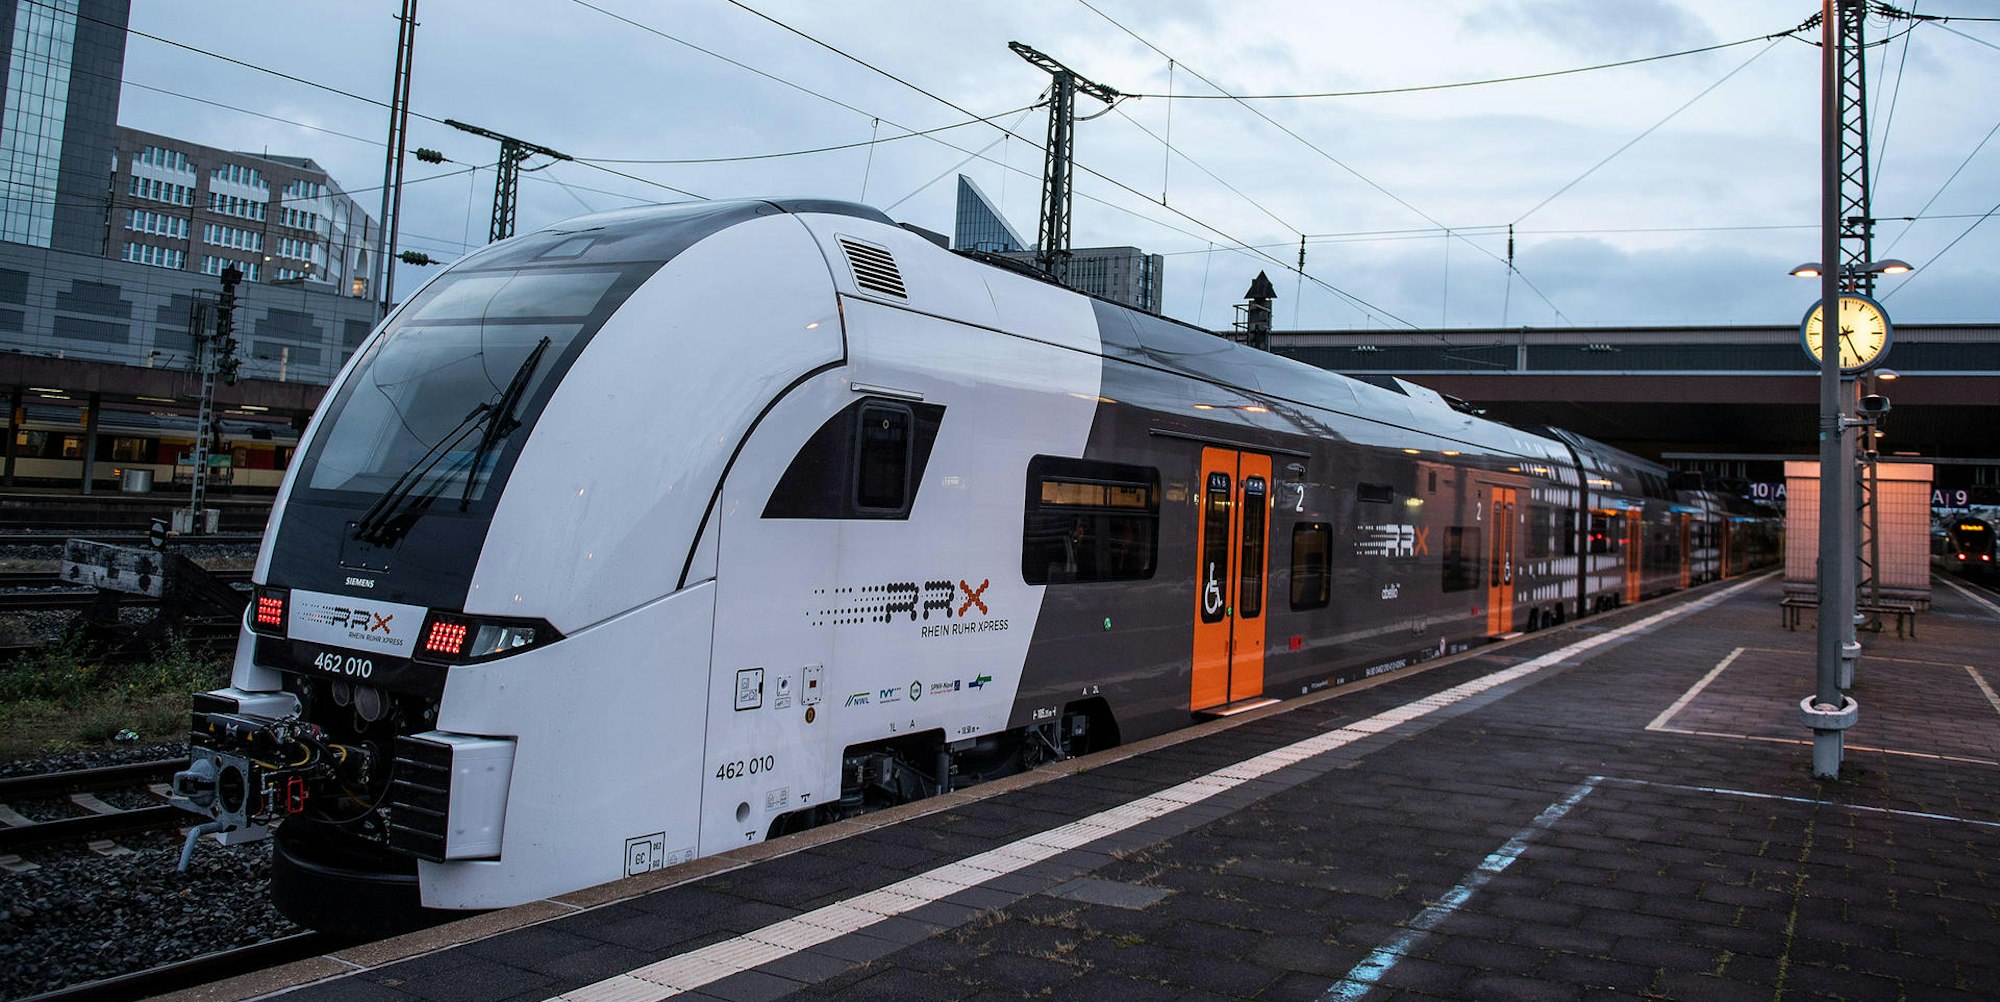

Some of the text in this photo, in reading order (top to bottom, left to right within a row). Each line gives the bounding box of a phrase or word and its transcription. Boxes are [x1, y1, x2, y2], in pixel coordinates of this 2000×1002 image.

[1296, 485, 1304, 512] 2
[1750, 482, 1787, 498] 10 A
[1932, 489, 1967, 505] A 9
[1476, 501, 1482, 520] 2
[345, 577, 375, 589] SIEMENS
[885, 578, 990, 624] RRX
[331, 606, 394, 635] RRX
[921, 619, 1009, 638] RHEIN RUHR XPRESS
[348, 631, 404, 647] RHEIN RUHR XPRESS
[314, 651, 373, 678] 462 010
[910, 719, 915, 729] A
[715, 755, 775, 781] 462 010
